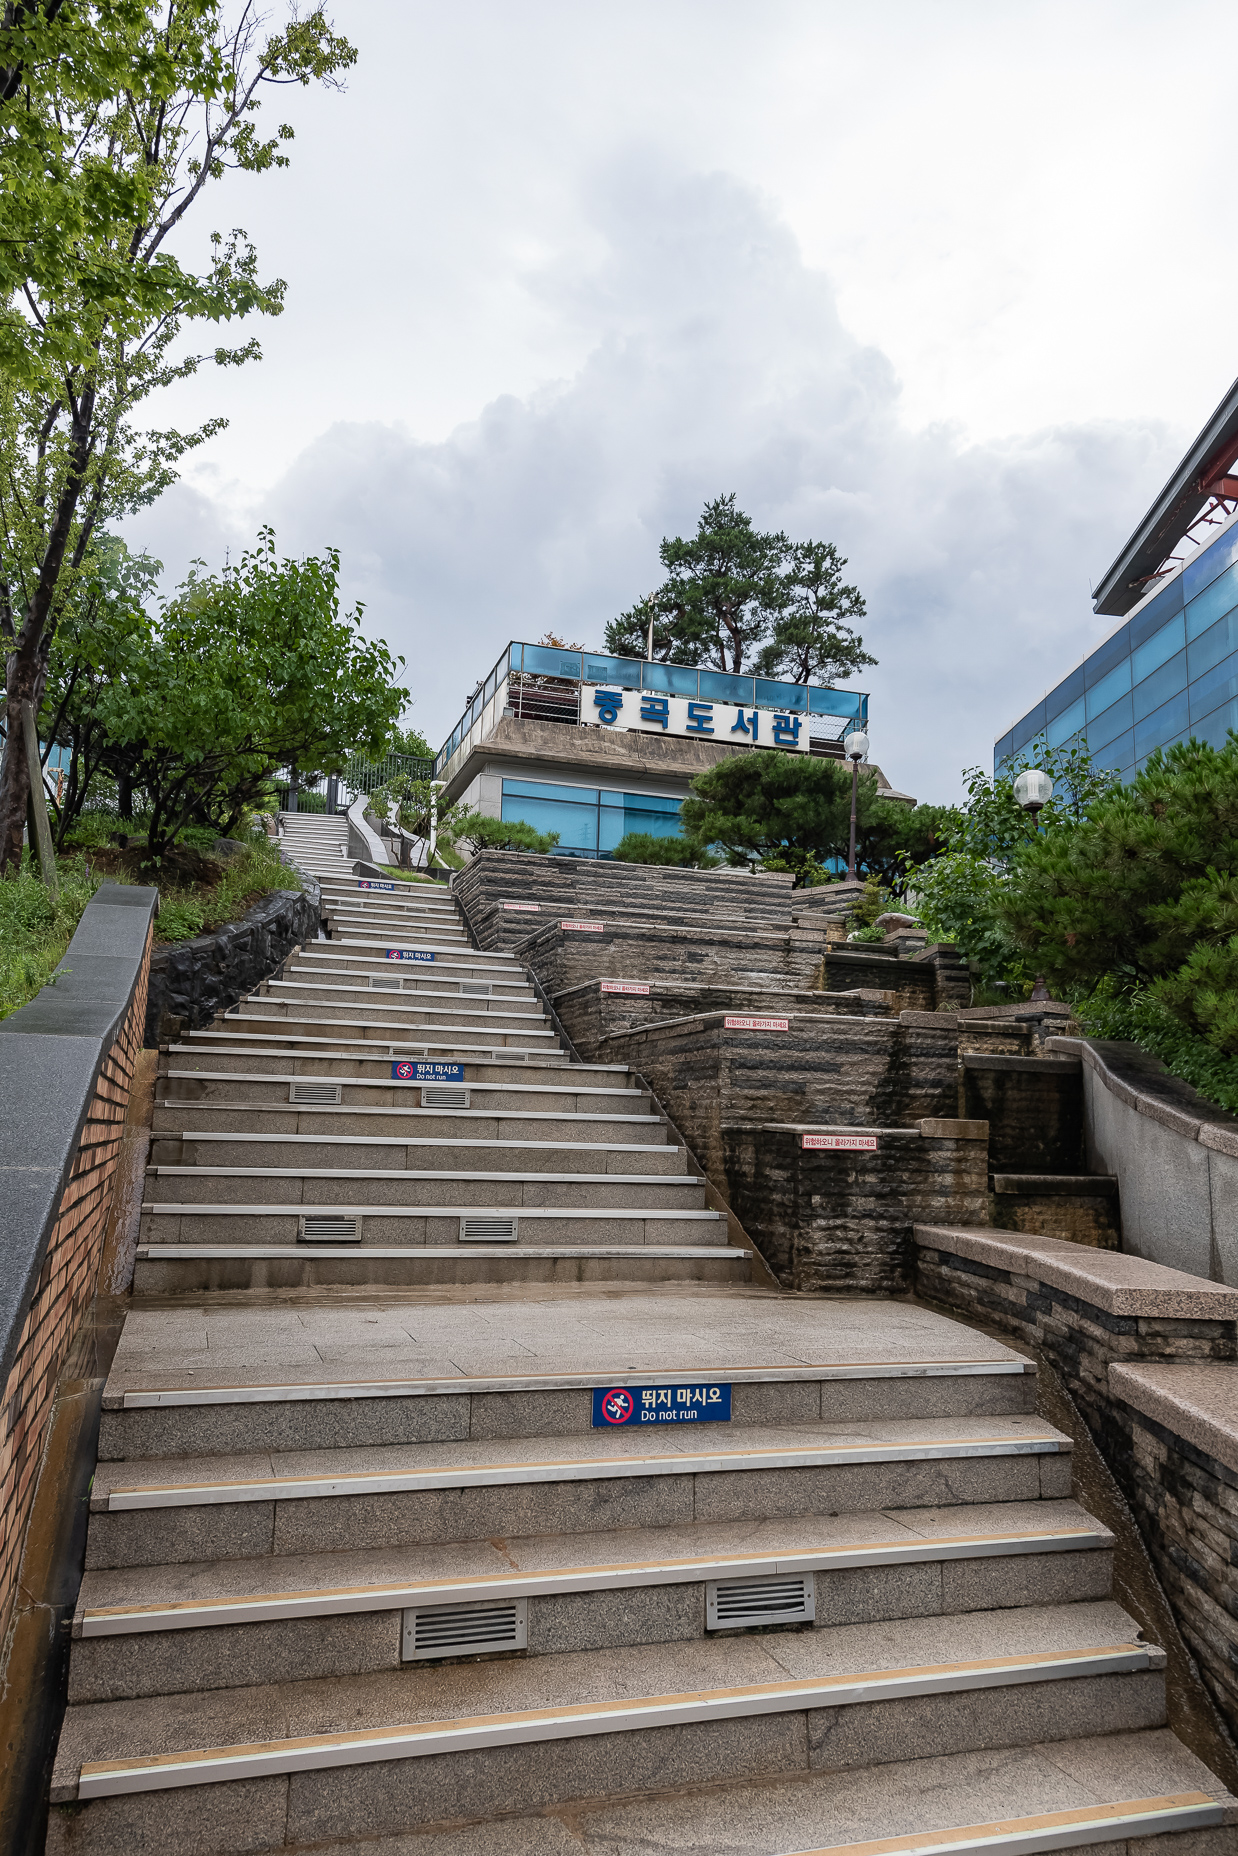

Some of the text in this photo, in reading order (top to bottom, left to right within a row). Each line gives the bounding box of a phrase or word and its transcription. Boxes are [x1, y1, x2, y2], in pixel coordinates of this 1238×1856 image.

[726, 1018, 750, 1026] 위험하오니
[417, 1064, 460, 1074] 뛰지 마시오
[804, 1138, 832, 1146] 위험하오니
[834, 1138, 857, 1146] 올라가지
[641, 1387, 722, 1408] 뛰지 마시오
[641, 1409, 698, 1421] Do not run
